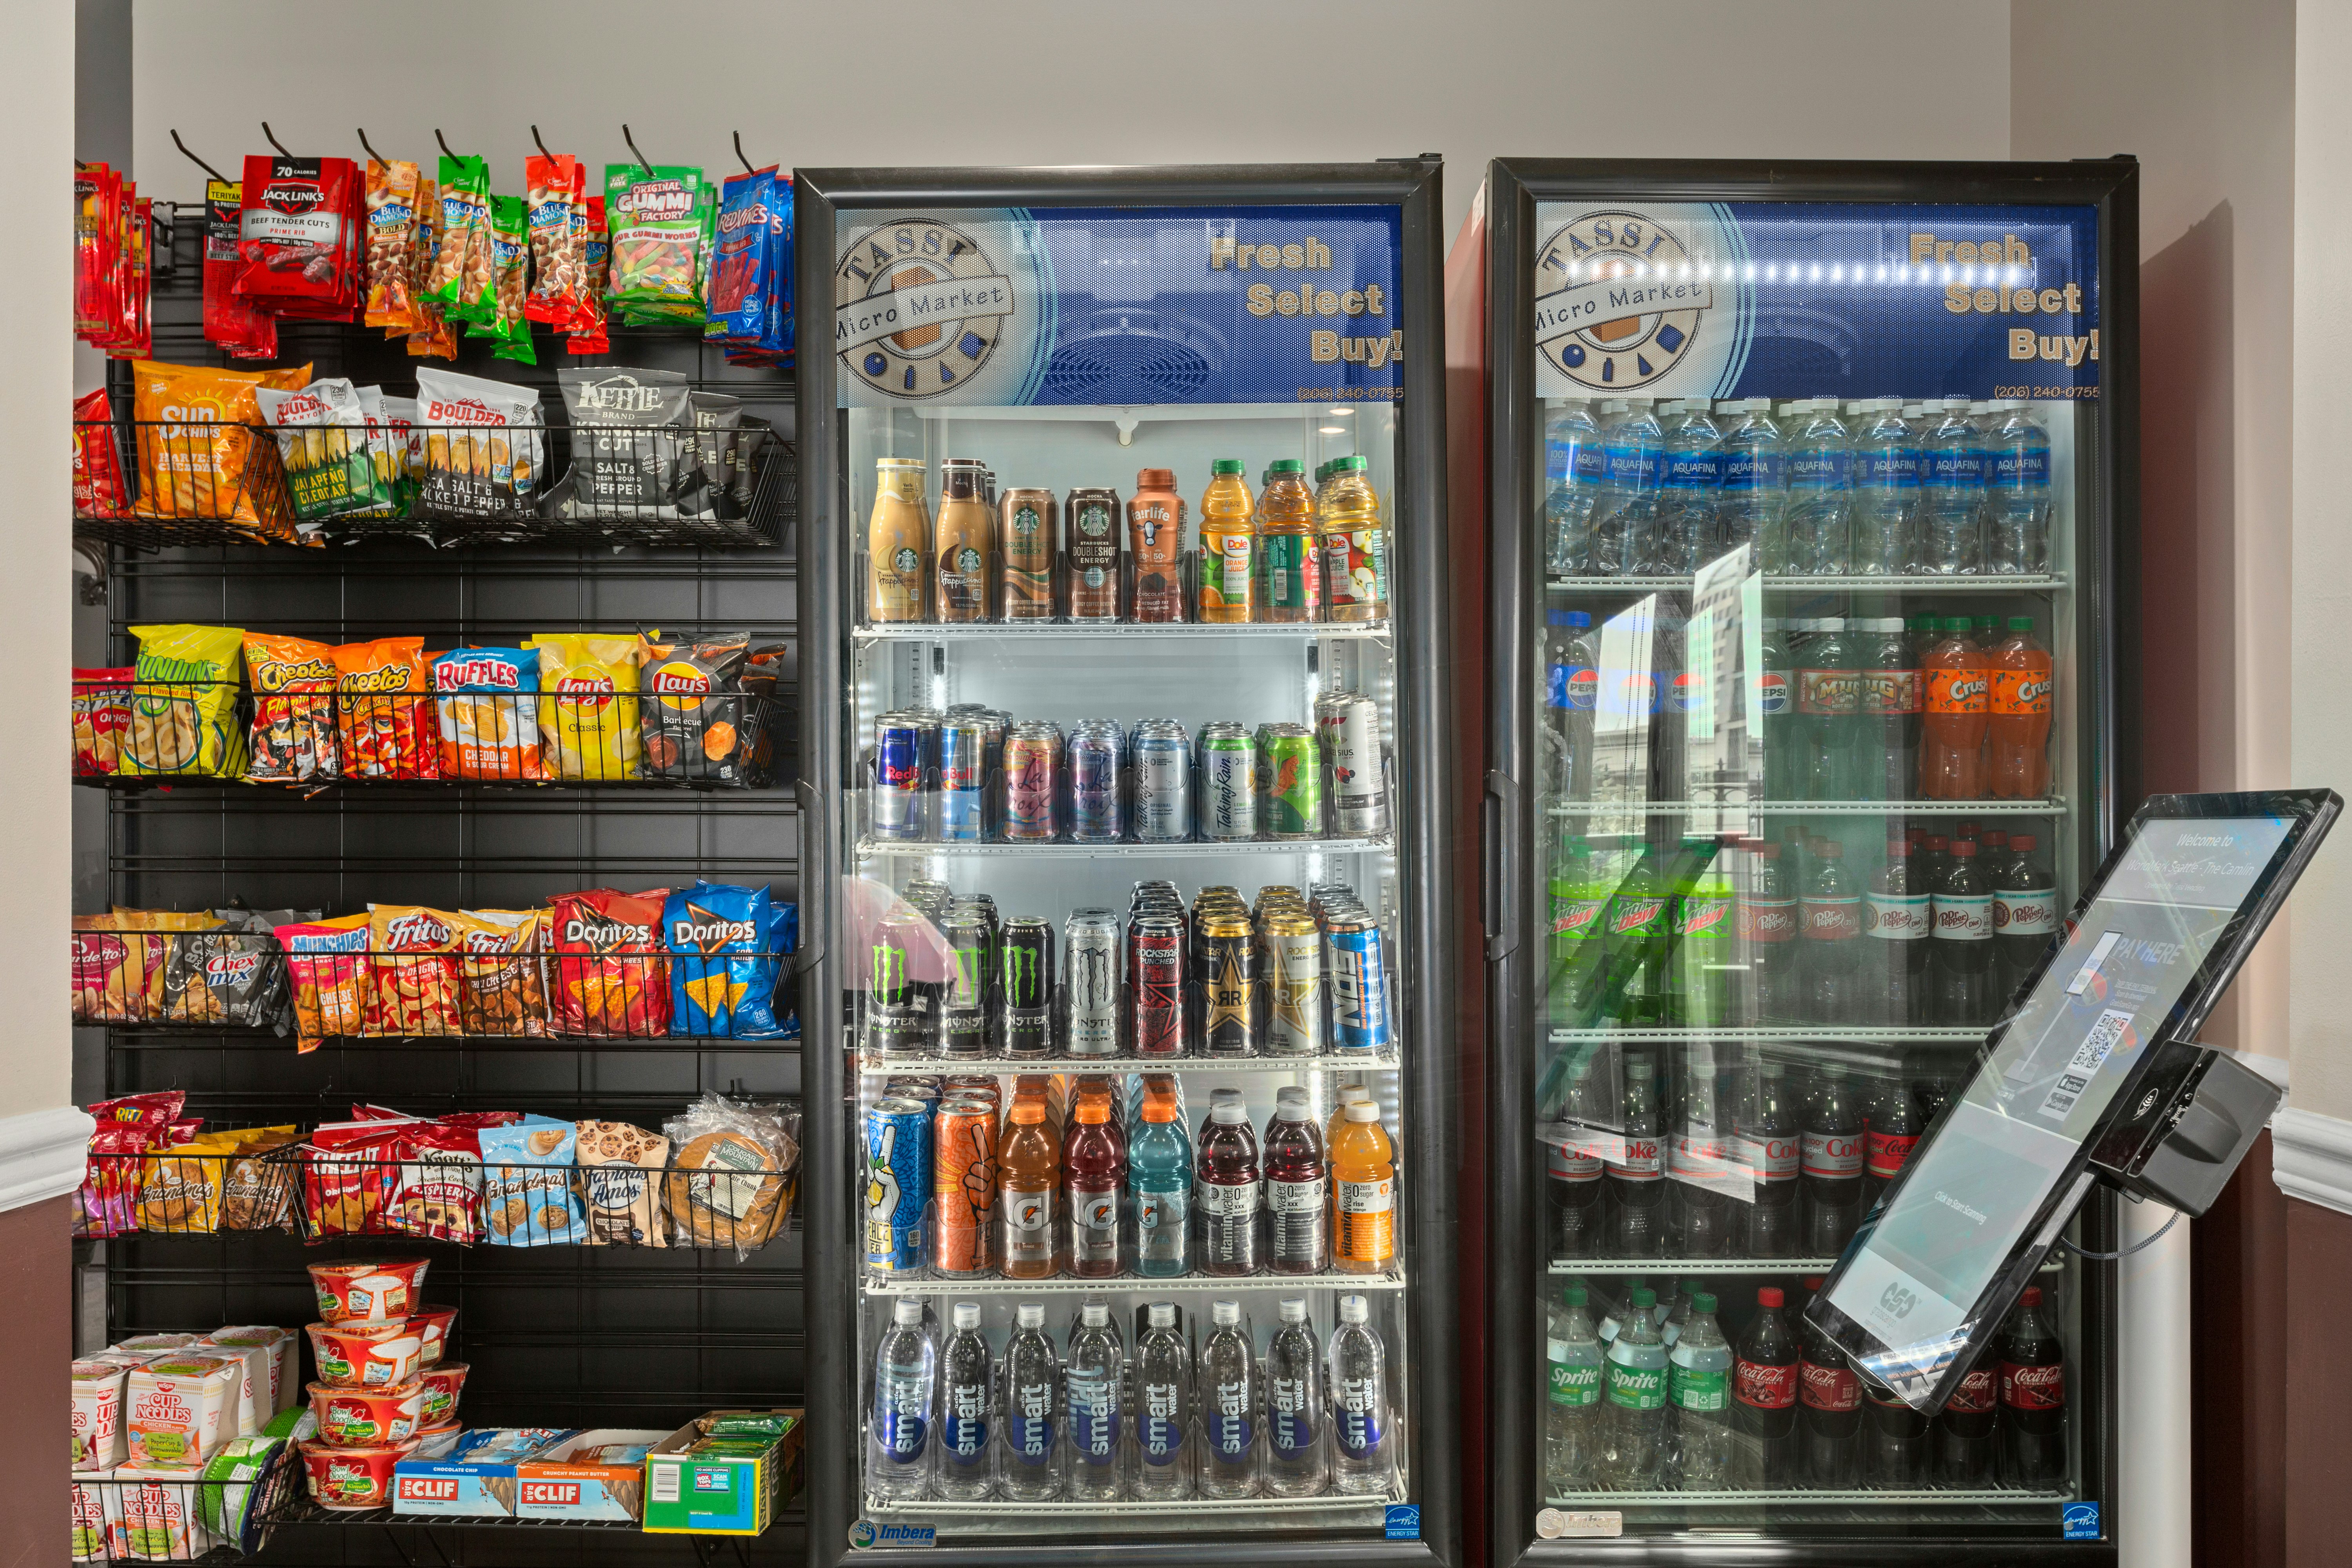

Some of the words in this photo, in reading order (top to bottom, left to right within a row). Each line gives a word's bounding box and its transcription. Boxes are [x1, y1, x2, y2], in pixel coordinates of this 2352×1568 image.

[277, 167, 292, 176] 70
[633, 182, 681, 193] ORIGINAL
[261, 190, 289, 201] JACK
[618, 192, 693, 212] GUMMI
[370, 209, 412, 223] DIAMOND
[381, 206, 401, 216] BLUE
[539, 203, 561, 216] BLUE
[641, 211, 685, 221] FACTORY
[307, 220, 330, 228] CUTS
[379, 225, 405, 234] BOLD
[665, 230, 697, 240] WORMS
[1211, 236, 1332, 270] Fresh
[1909, 233, 2031, 268] Fresh
[911, 288, 1003, 315] Market
[1246, 283, 1386, 319] Select
[1610, 282, 1702, 307] Market
[1944, 281, 2083, 315] Select
[1310, 328, 1403, 370] Buy!
[2009, 328, 2098, 368] Buy!
[575, 381, 664, 411] KETTLE
[1994, 385, 2030, 399] (206)
[427, 401, 506, 426] BOULDER
[599, 438, 633, 450] CUT
[597, 462, 628, 474] SALT
[1673, 463, 1716, 474] AQUAFINA
[1874, 461, 1916, 472] AQUAFINA
[1998, 459, 2042, 471] AQUAFINA
[1073, 547, 1116, 556] DOUBLESHOT
[1228, 539, 1248, 549] Dole
[438, 661, 517, 691] RUFFLES
[340, 666, 409, 711] Cheetos
[569, 723, 606, 732] Classic
[465, 750, 508, 762] CHEDDAR
[2177, 833, 2221, 847] Welcome
[2222, 835, 2234, 847] to
[2169, 861, 2198, 874] Seattle
[2203, 862, 2221, 874] The
[2221, 863, 2254, 876] Camlin
[1947, 911, 1959, 921] Dr
[2022, 905, 2033, 915] Dr
[388, 914, 450, 951] Fritos
[567, 921, 651, 943] Doritos
[676, 920, 757, 943] Doritos
[2113, 938, 2145, 960] PAY
[2140, 941, 2185, 965] HERE
[207, 954, 259, 972] Chex
[754, 1009, 767, 1018] 260
[116, 1107, 143, 1122] RITZ
[720, 1147, 758, 1171] MOUNTAIN
[728, 1144, 757, 1162] COUGAR
[741, 1180, 757, 1192] Chunk
[1935, 1191, 1947, 1204] Click
[1947, 1197, 1953, 1205] to
[1952, 1199, 1965, 1215] Start
[1964, 1205, 1987, 1225] Scanning
[1552, 1368, 1597, 1386] Sprite
[1612, 1368, 1658, 1389] Sprite
[150, 1393, 181, 1408] CUP
[136, 1404, 191, 1423] NOODLES
[331, 1407, 351, 1416] Bowl
[330, 1414, 361, 1425] Noodles
[959, 1385, 976, 1455] smart
[1025, 1384, 1042, 1455] smart
[1149, 1384, 1167, 1455] smart
[330, 1464, 350, 1474] Bowl
[330, 1471, 359, 1481] Noodles
[412, 1481, 454, 1497] CLIF
[534, 1486, 576, 1501] CLIF
[880, 1524, 935, 1539] Imbera
